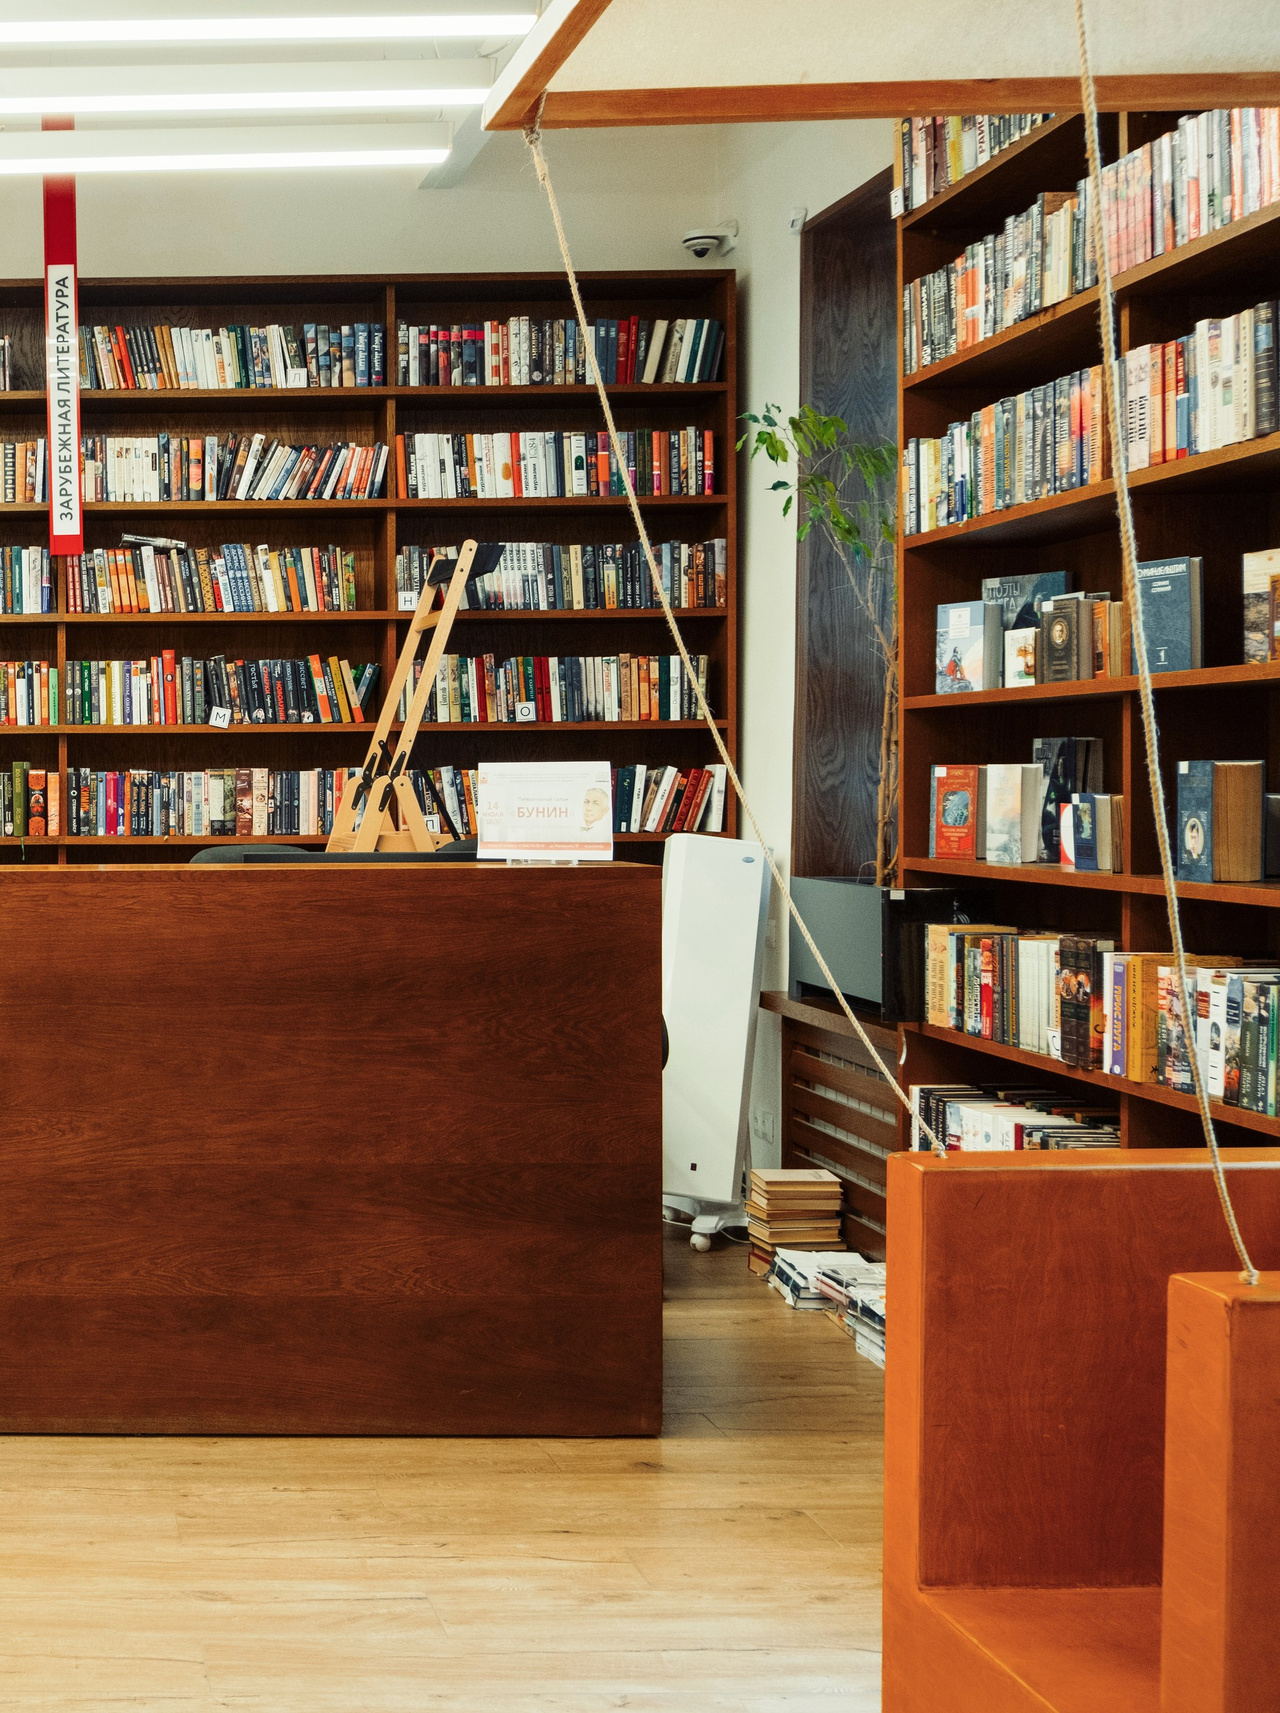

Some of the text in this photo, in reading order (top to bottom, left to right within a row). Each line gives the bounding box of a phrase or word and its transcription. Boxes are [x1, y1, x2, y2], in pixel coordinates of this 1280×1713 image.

[358, 332, 367, 350] Роберт
[372, 333, 382, 351] Роберт
[292, 371, 301, 384] Л
[55, 276, 73, 521] ЗАРУБЕЖНАЯ ЛИТЕРАТУРА
[529, 438, 538, 459] 1Q84
[237, 579, 245, 605] ЛЕССИНГ
[243, 579, 251, 605] ЛЕССИНГ
[251, 579, 260, 605] ЛЕССИНГ
[988, 582, 1020, 598] ПОЭТЫ
[404, 596, 412, 606] Н
[298, 661, 306, 689] рассвет
[276, 681, 285, 720] НОВОЛУНИЕ
[214, 711, 226, 721] М
[520, 706, 531, 717] О
[487, 801, 499, 810] 14
[1113, 985, 1122, 1051] ПРИСЛУГА
